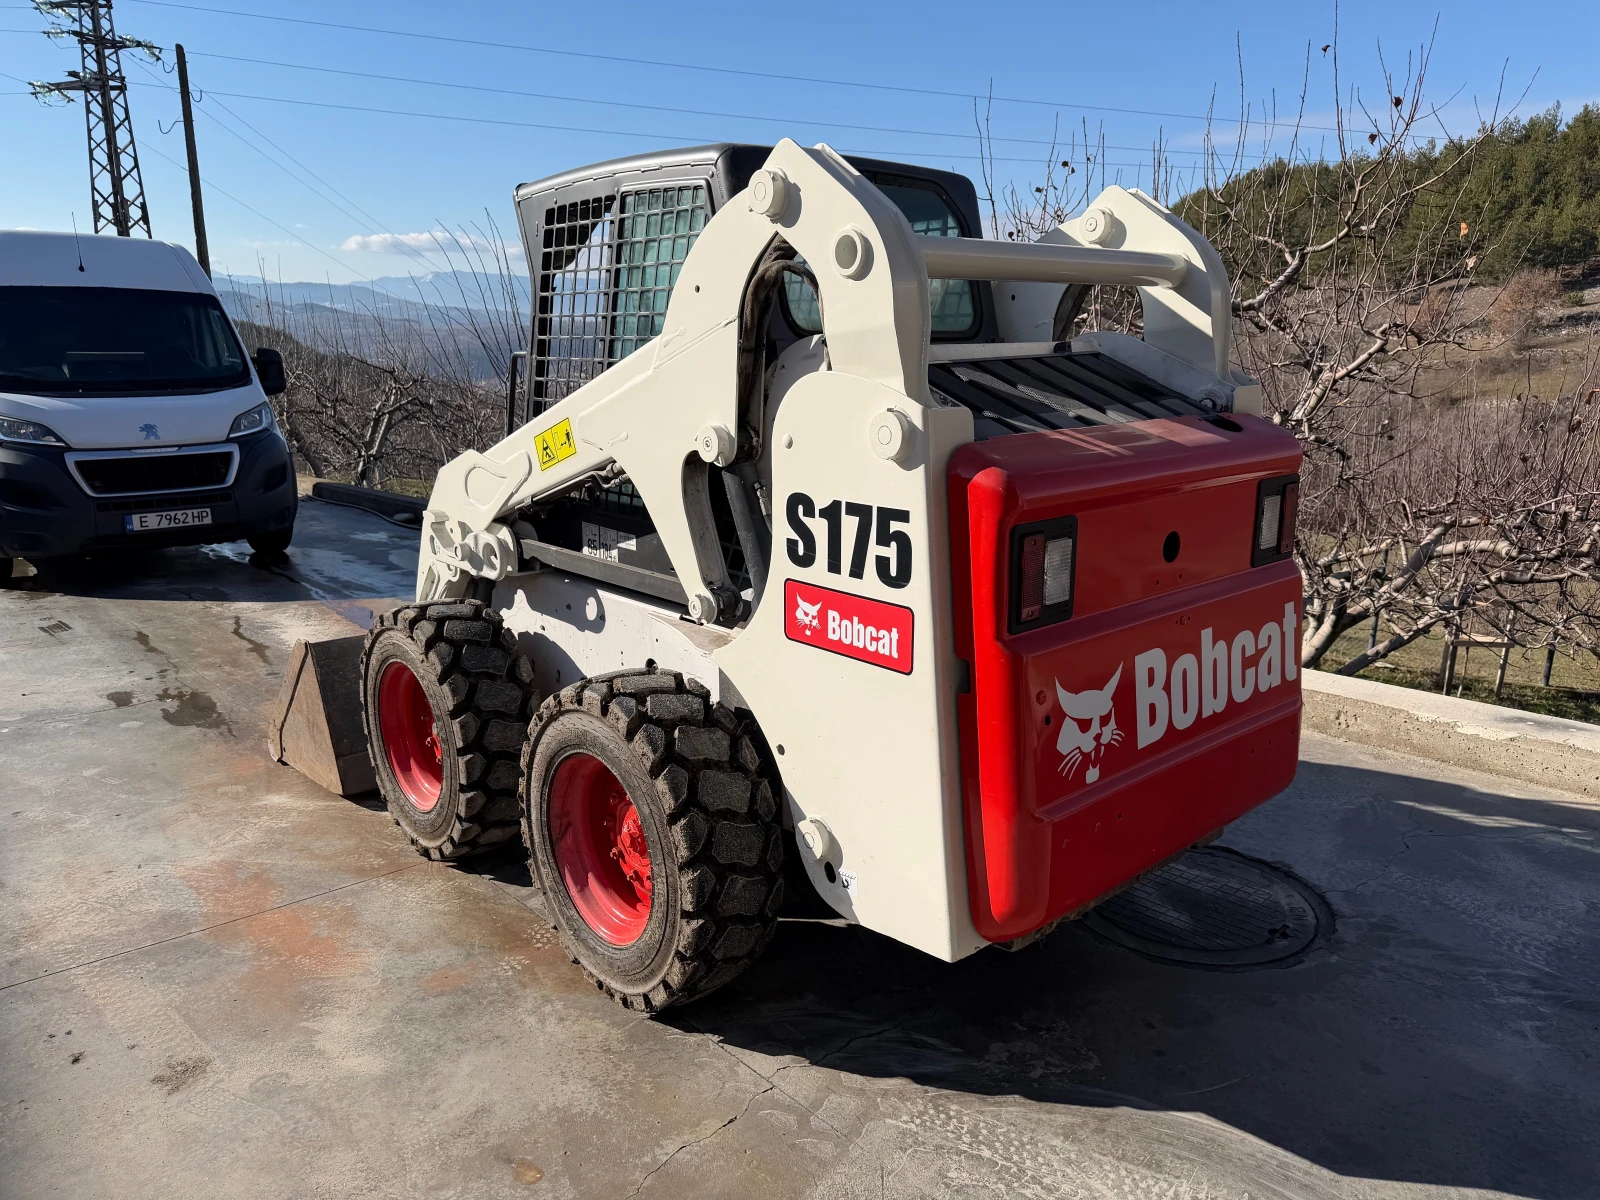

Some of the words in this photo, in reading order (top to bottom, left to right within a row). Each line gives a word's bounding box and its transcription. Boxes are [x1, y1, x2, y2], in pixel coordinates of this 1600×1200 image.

[140, 516, 149, 528] E
[156, 512, 189, 526] 7962
[191, 510, 209, 523] HP
[786, 492, 912, 589] S175
[828, 610, 898, 658] Bobcat
[1135, 602, 1297, 750] Bobcat
